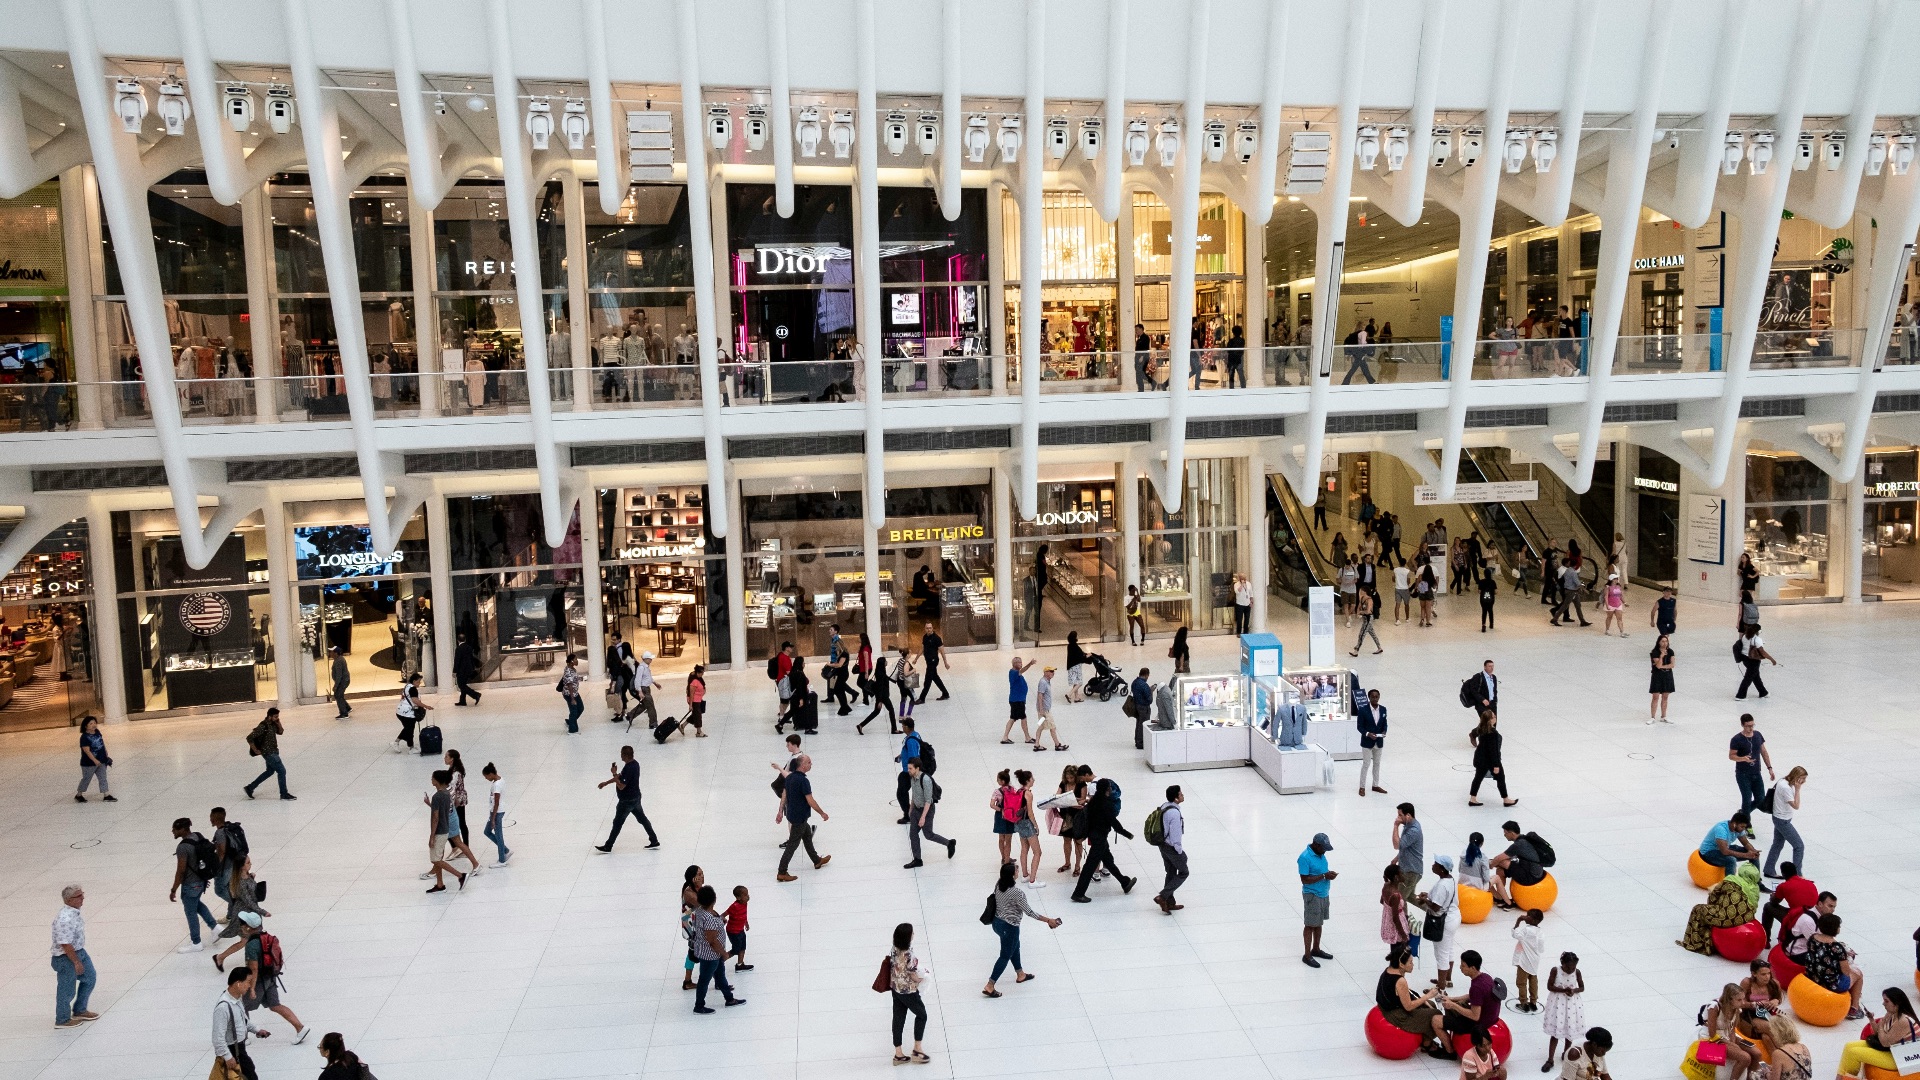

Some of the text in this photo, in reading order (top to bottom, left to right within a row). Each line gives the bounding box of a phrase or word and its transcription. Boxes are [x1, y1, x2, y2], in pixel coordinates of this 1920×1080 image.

[757, 248, 831, 274] Dior
[1634, 255, 1685, 270] COLE HAAN
[1760, 298, 1812, 329] Pinch
[1634, 477, 1678, 491] ROBERTO COIN
[1036, 510, 1099, 526] LONDON
[890, 526, 984, 542] BREITLING
[620, 544, 697, 559] MONTBLANC
